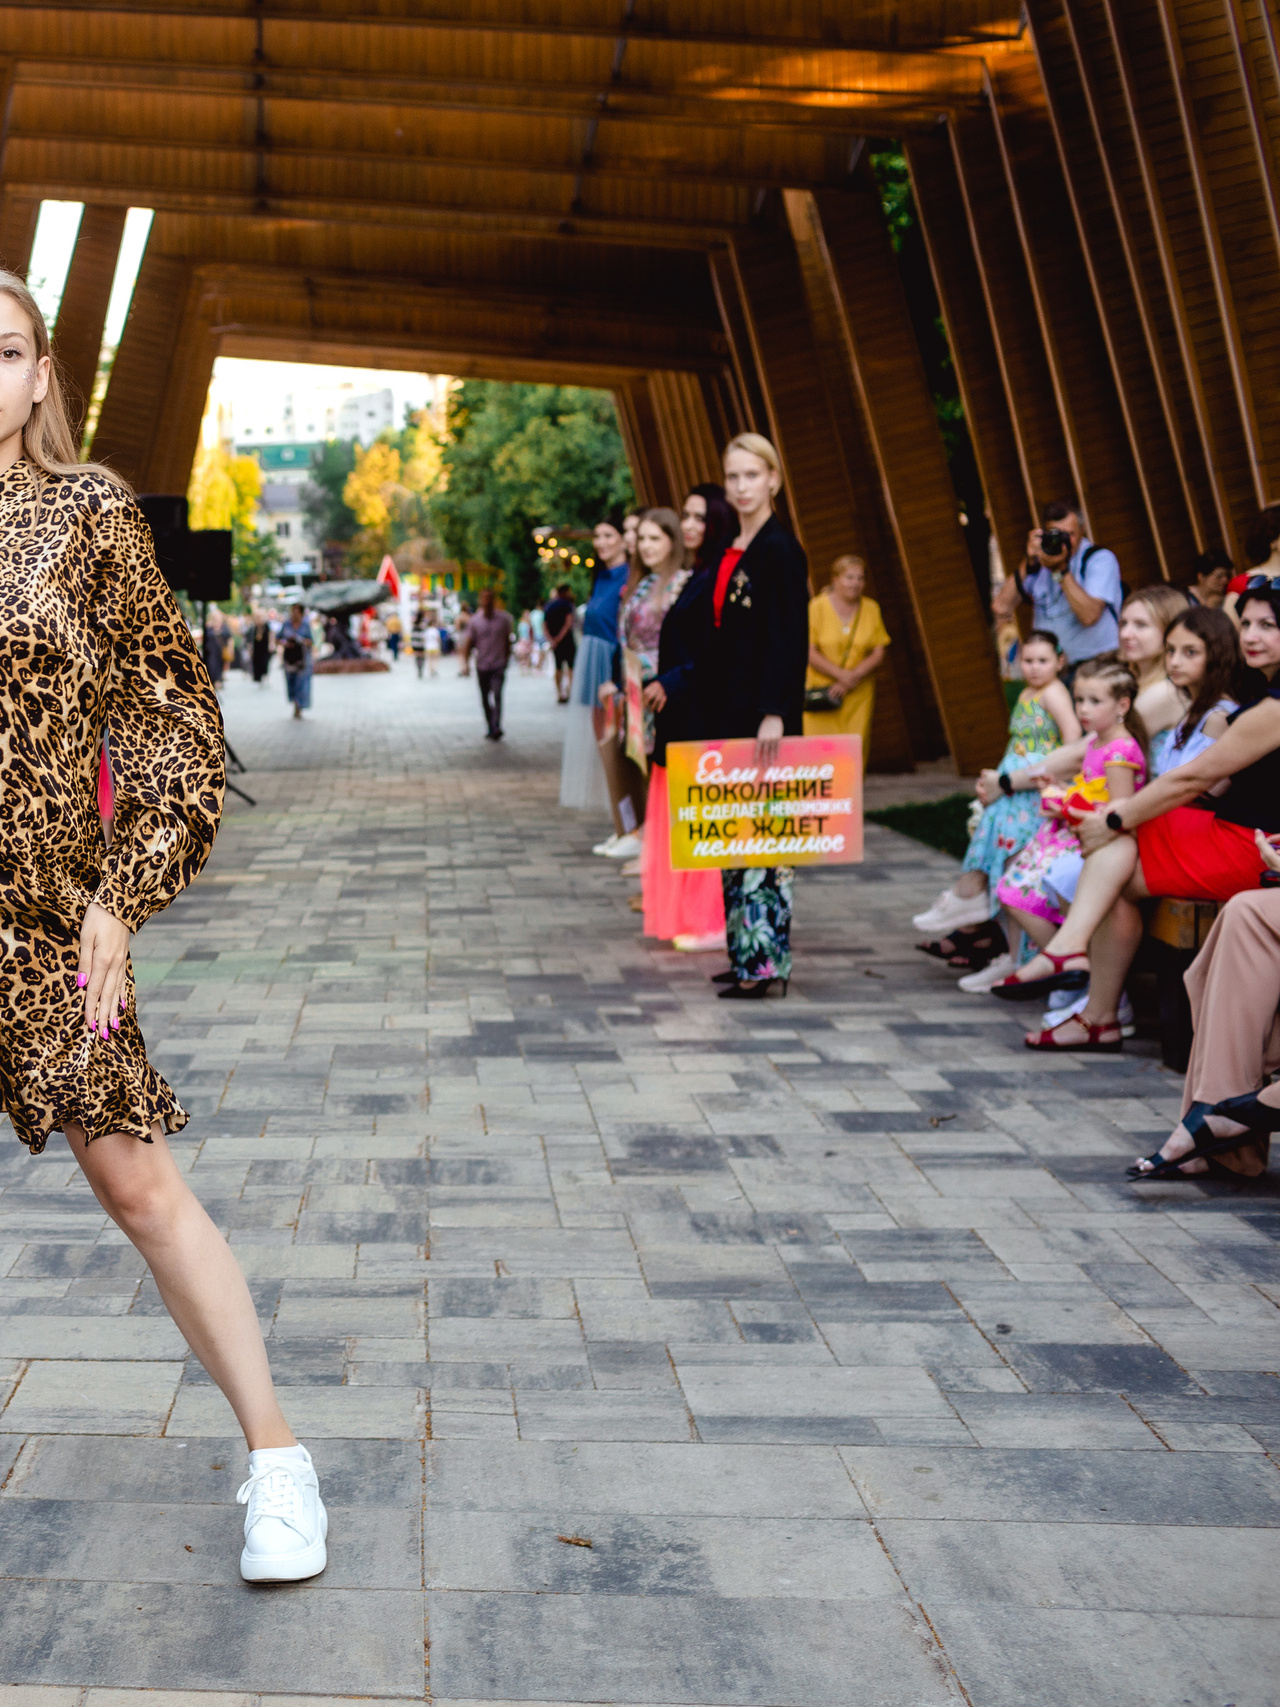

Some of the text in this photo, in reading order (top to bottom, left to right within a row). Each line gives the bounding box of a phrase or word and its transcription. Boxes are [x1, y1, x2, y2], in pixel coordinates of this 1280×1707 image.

[695, 750, 835, 784] Если наше
[687, 778, 833, 803] ПОКОЛЕНИЕ
[678, 805, 698, 822] НЕ
[701, 801, 766, 821] СДЕЛАЕТ
[688, 820, 739, 840] НАС
[692, 833, 846, 857] немыслимое
